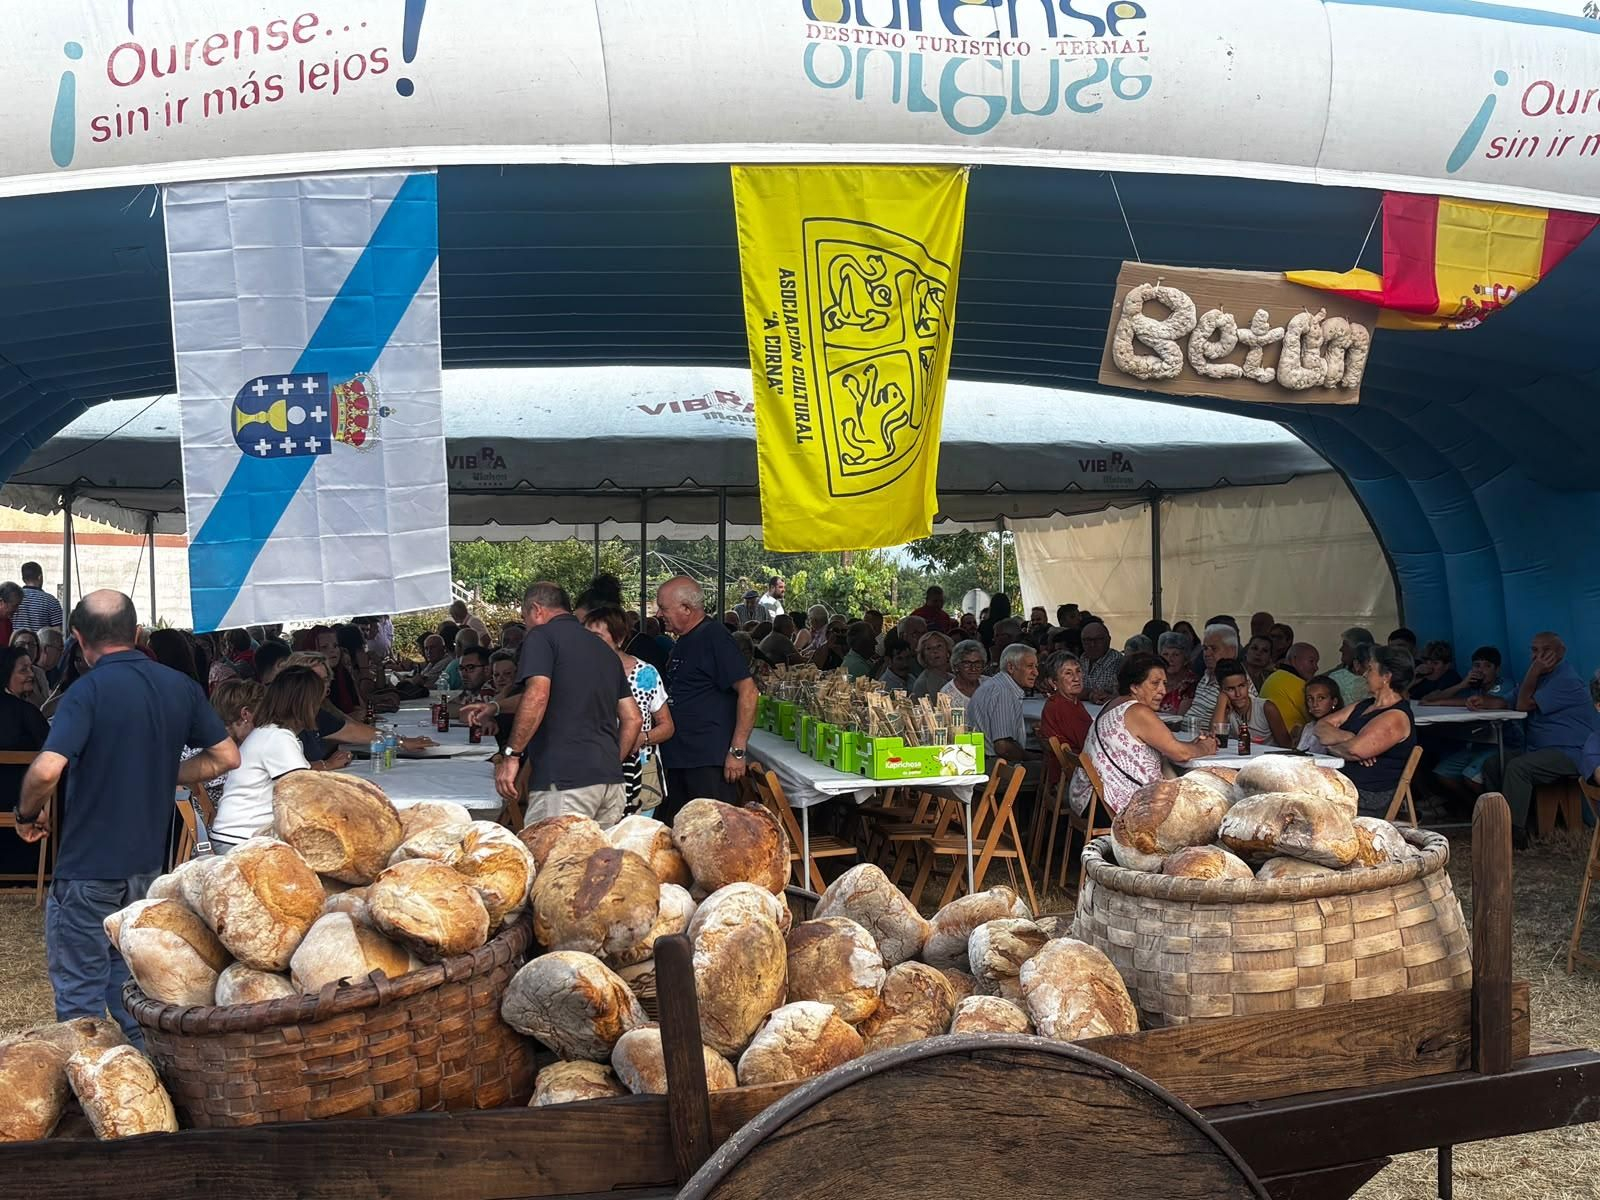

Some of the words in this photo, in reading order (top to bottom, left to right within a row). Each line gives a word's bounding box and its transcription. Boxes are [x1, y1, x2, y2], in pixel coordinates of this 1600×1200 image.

[805, 23, 906, 48] DESTINO
[916, 35, 1031, 57] TURISTICO
[1055, 39, 1151, 56] TERMAL
[91, 103, 149, 142] sin
[165, 92, 189, 127] ir
[203, 70, 284, 118] más
[299, 47, 389, 95] lejos
[1485, 129, 1540, 158] sin
[1546, 129, 1575, 157] ir
[792, 364, 813, 444] CULTURAL
[1078, 451, 1134, 472] VIBRA
